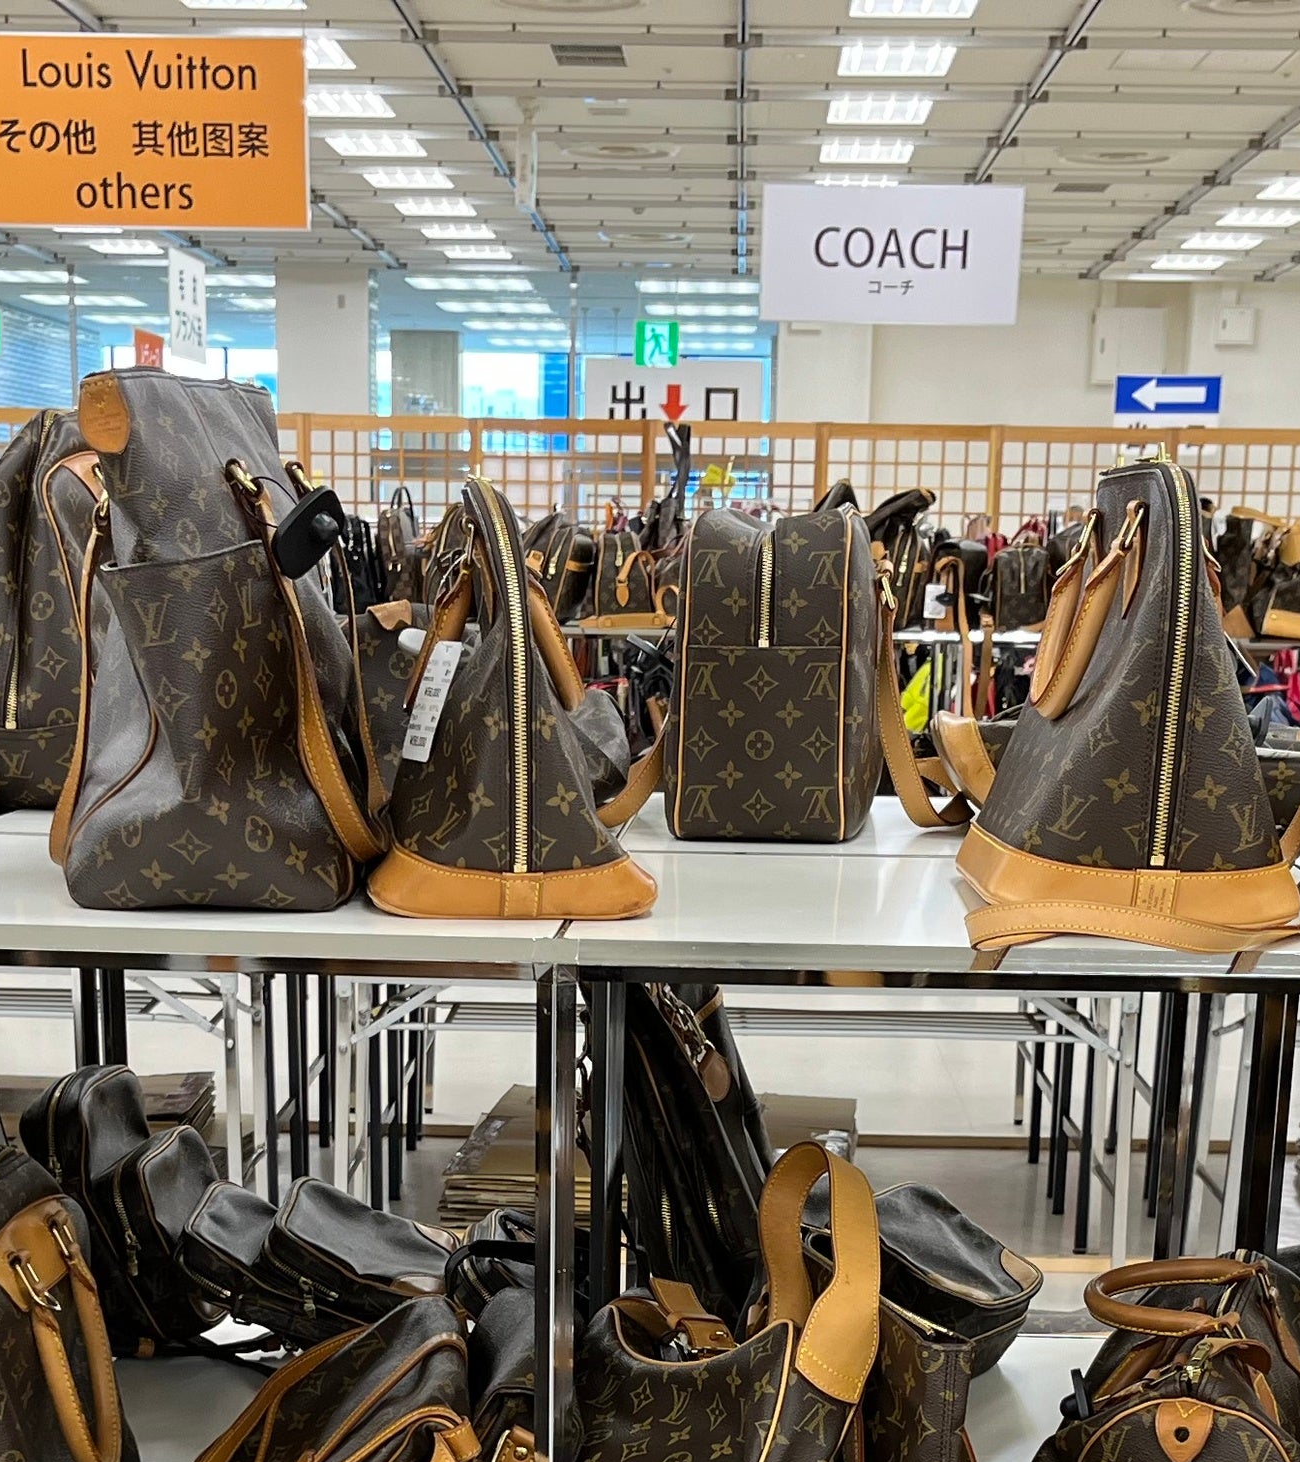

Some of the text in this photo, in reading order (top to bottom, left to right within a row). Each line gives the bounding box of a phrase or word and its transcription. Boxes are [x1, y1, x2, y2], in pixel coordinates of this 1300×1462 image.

[21, 48, 257, 91] Louis Vuitton
[132, 120, 270, 158] 其他图案
[76, 172, 194, 210] others
[814, 226, 969, 269] COACH
[868, 280, 914, 295] コーチ
